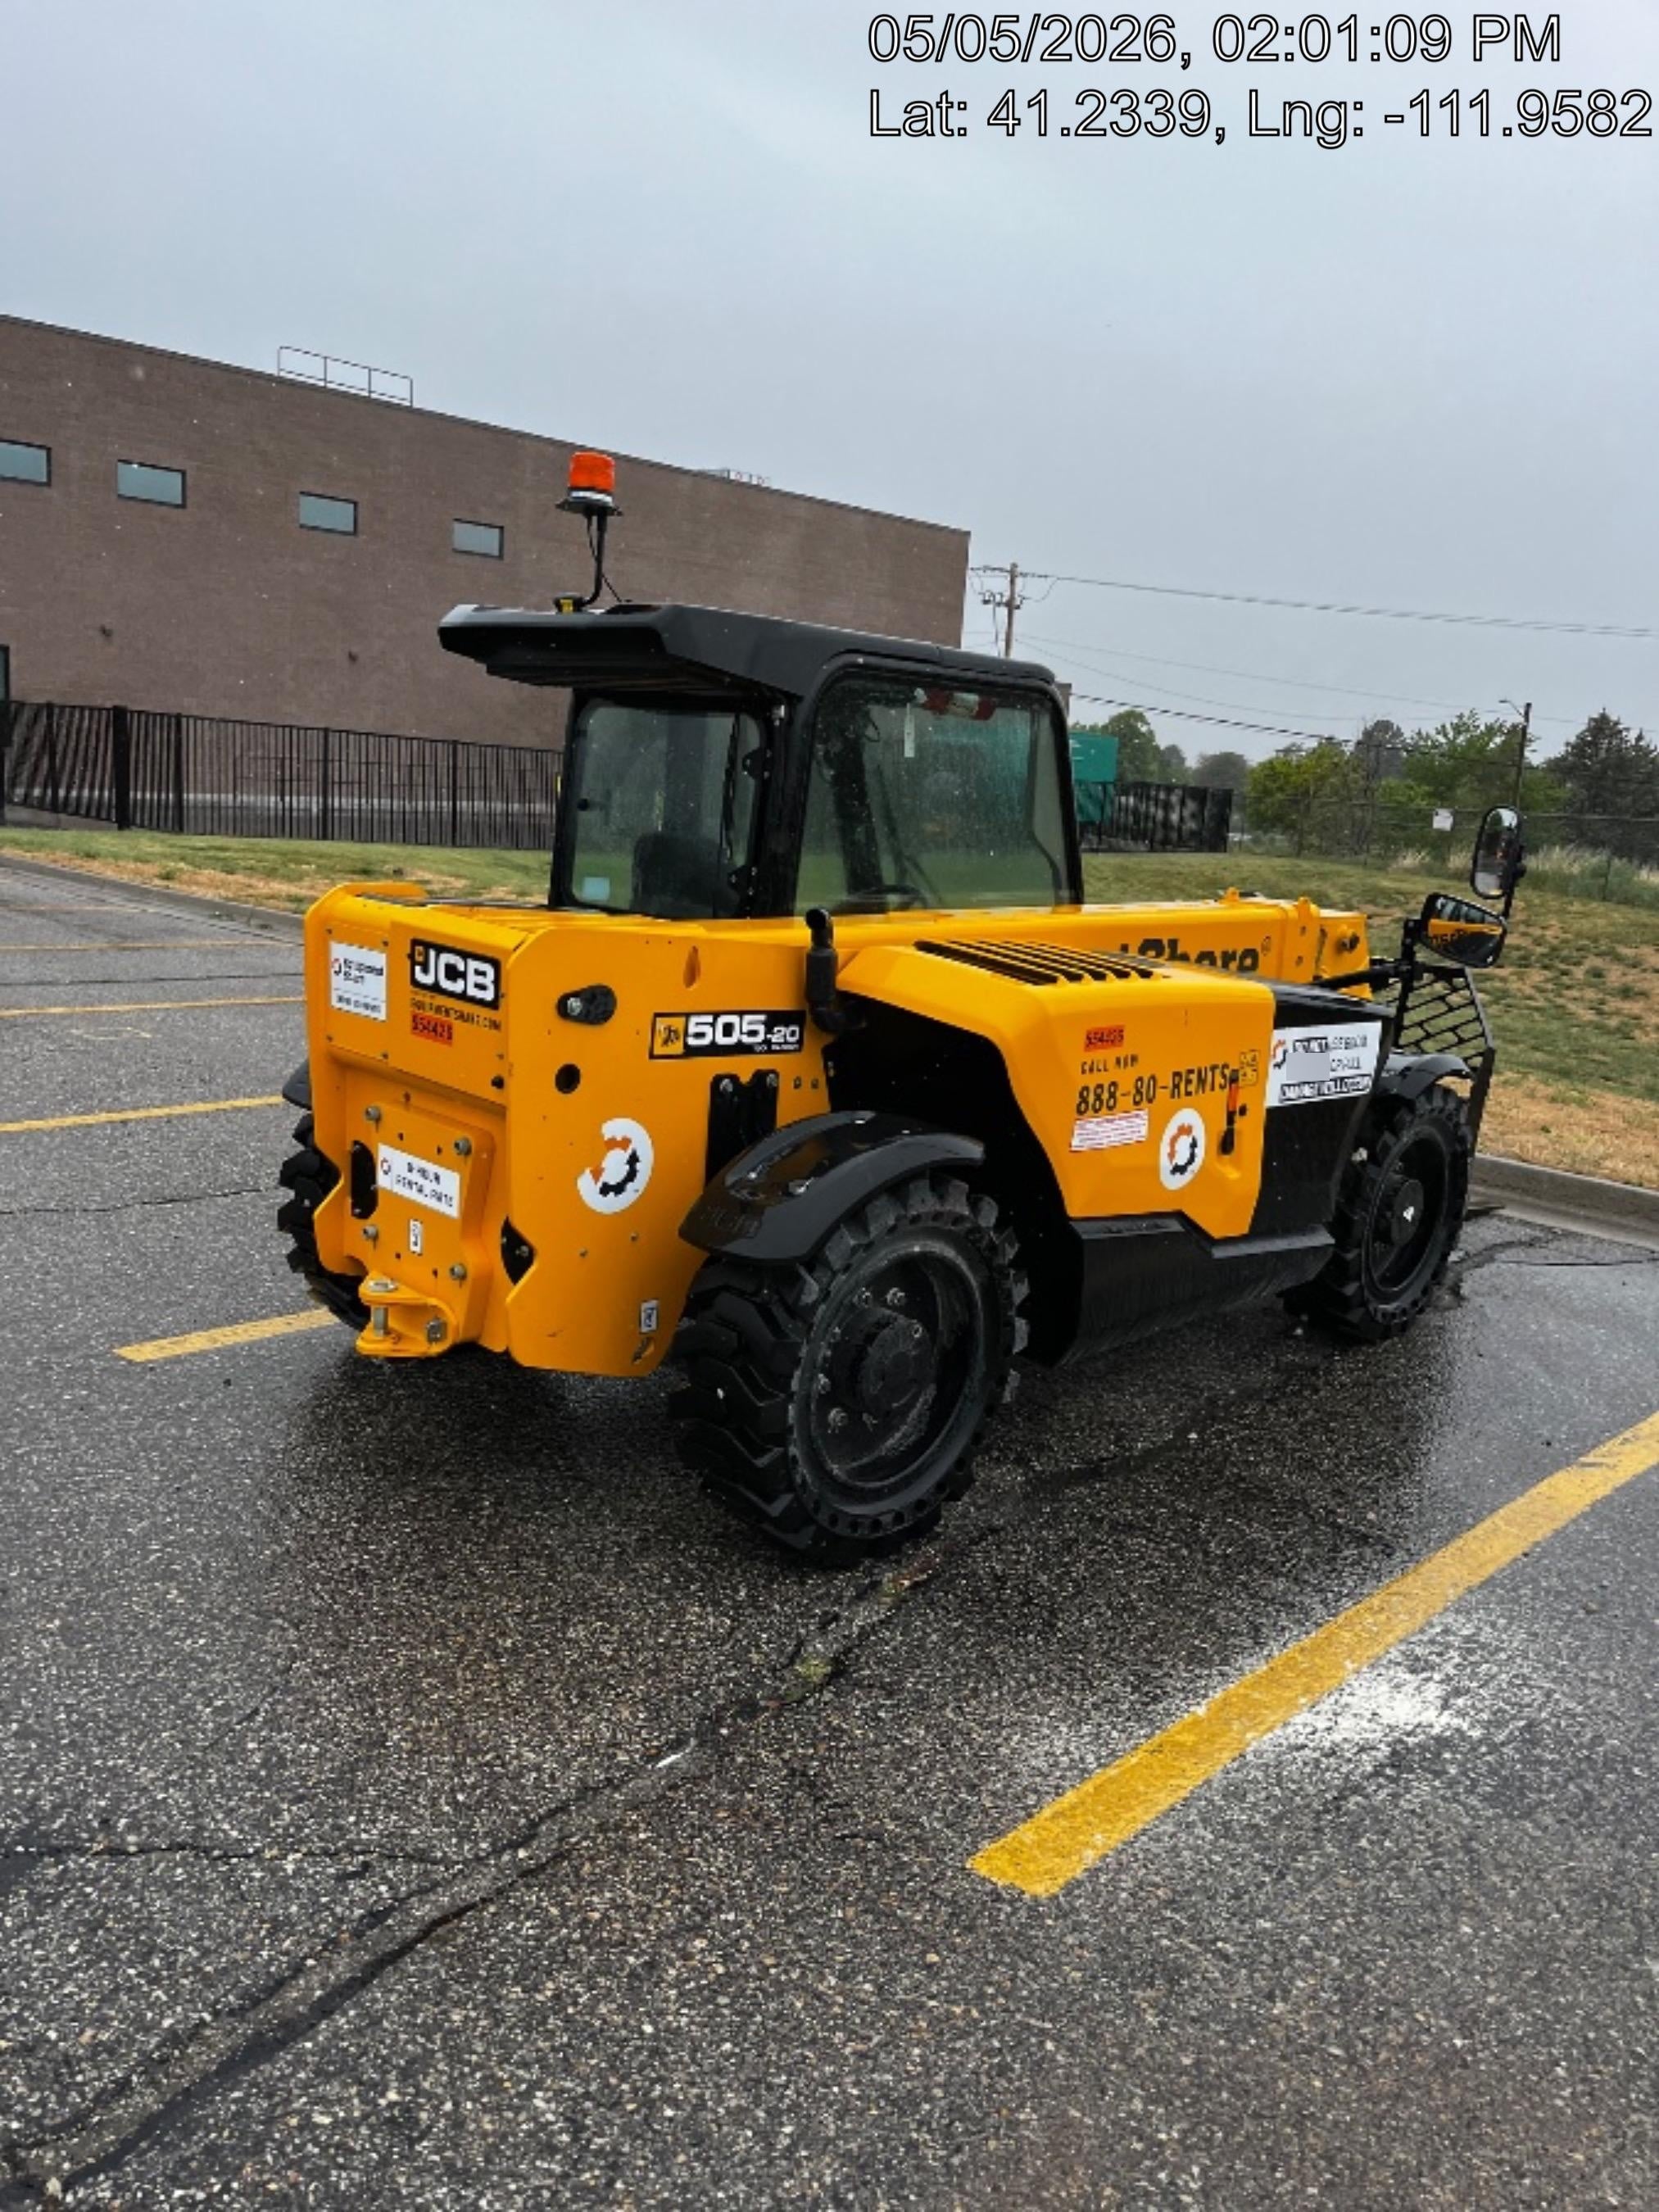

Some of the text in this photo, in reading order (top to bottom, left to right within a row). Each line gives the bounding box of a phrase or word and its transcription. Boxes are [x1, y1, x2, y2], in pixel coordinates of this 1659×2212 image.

[414, 948, 495, 1001] JCB
[687, 1014, 800, 1045] 505-20
[1077, 1063, 1230, 1116] 888-80-RENTS
